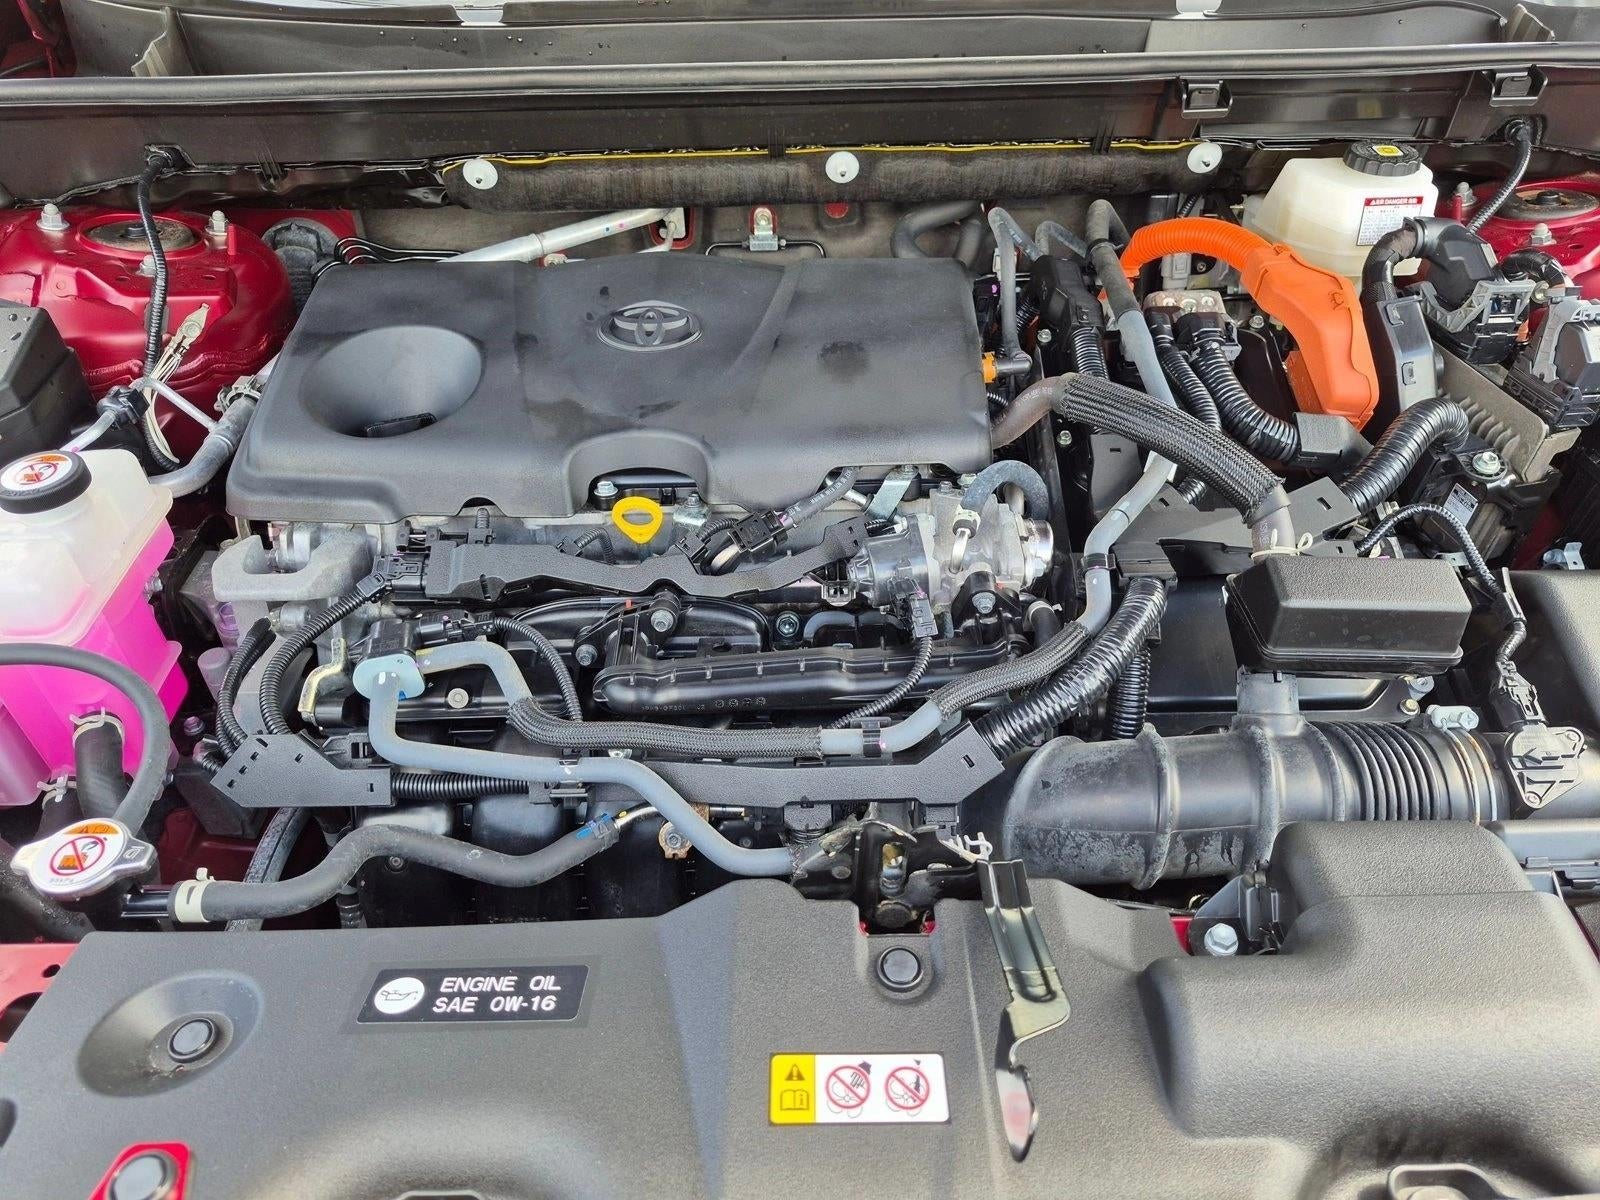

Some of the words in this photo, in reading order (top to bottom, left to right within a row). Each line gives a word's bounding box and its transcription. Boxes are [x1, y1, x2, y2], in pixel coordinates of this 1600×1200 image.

[440, 976, 517, 992] ENGINE
[529, 976, 562, 991] OIL
[432, 996, 479, 1013] SAE
[489, 995, 557, 1012] 0W-16
